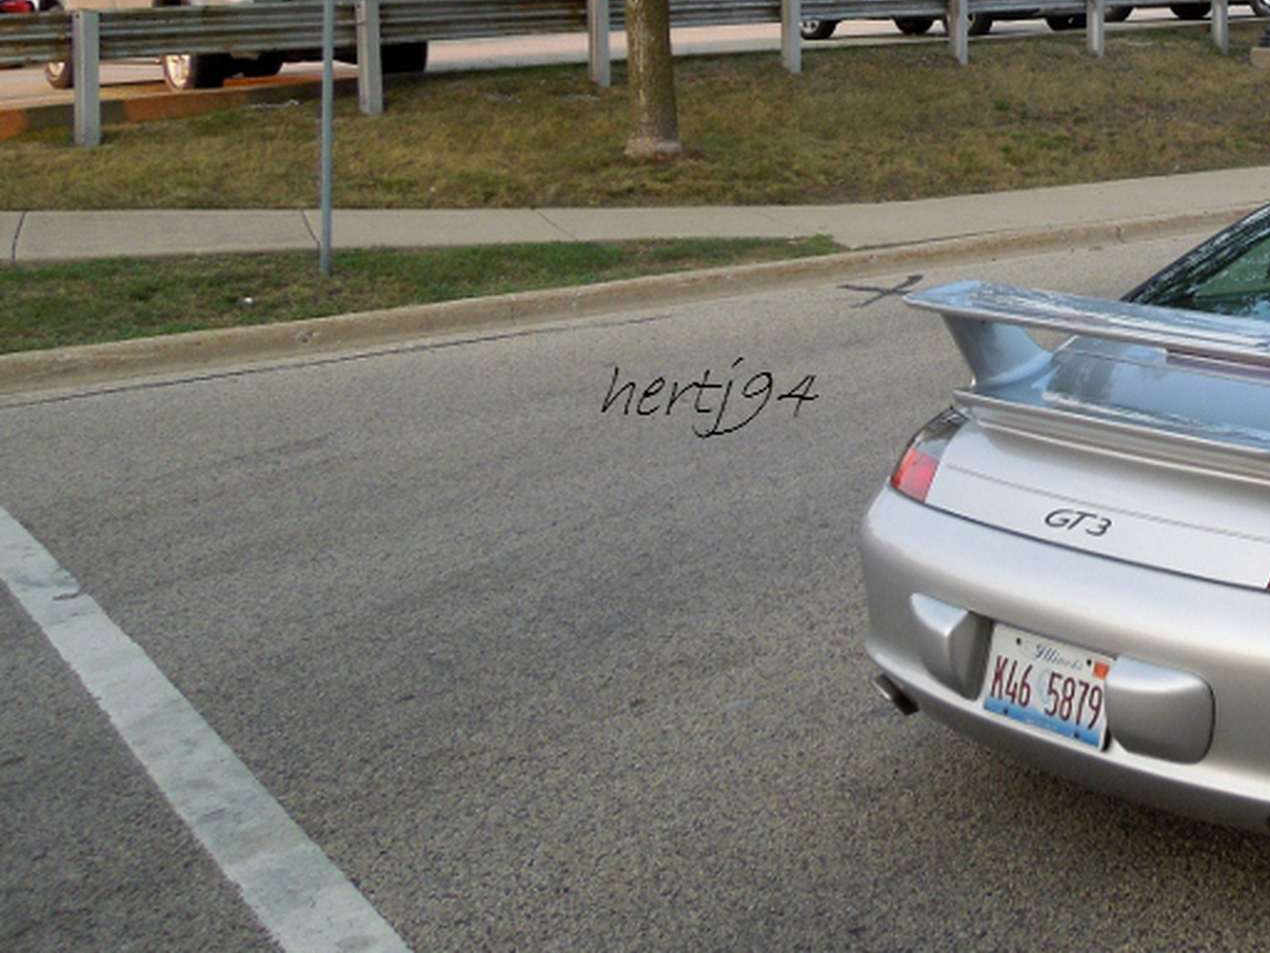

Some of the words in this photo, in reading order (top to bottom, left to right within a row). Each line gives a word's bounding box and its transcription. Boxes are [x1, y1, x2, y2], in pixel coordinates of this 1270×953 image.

[1045, 509, 1112, 537] GT3
[990, 655, 1033, 707] K46
[1044, 671, 1102, 730] 5879
